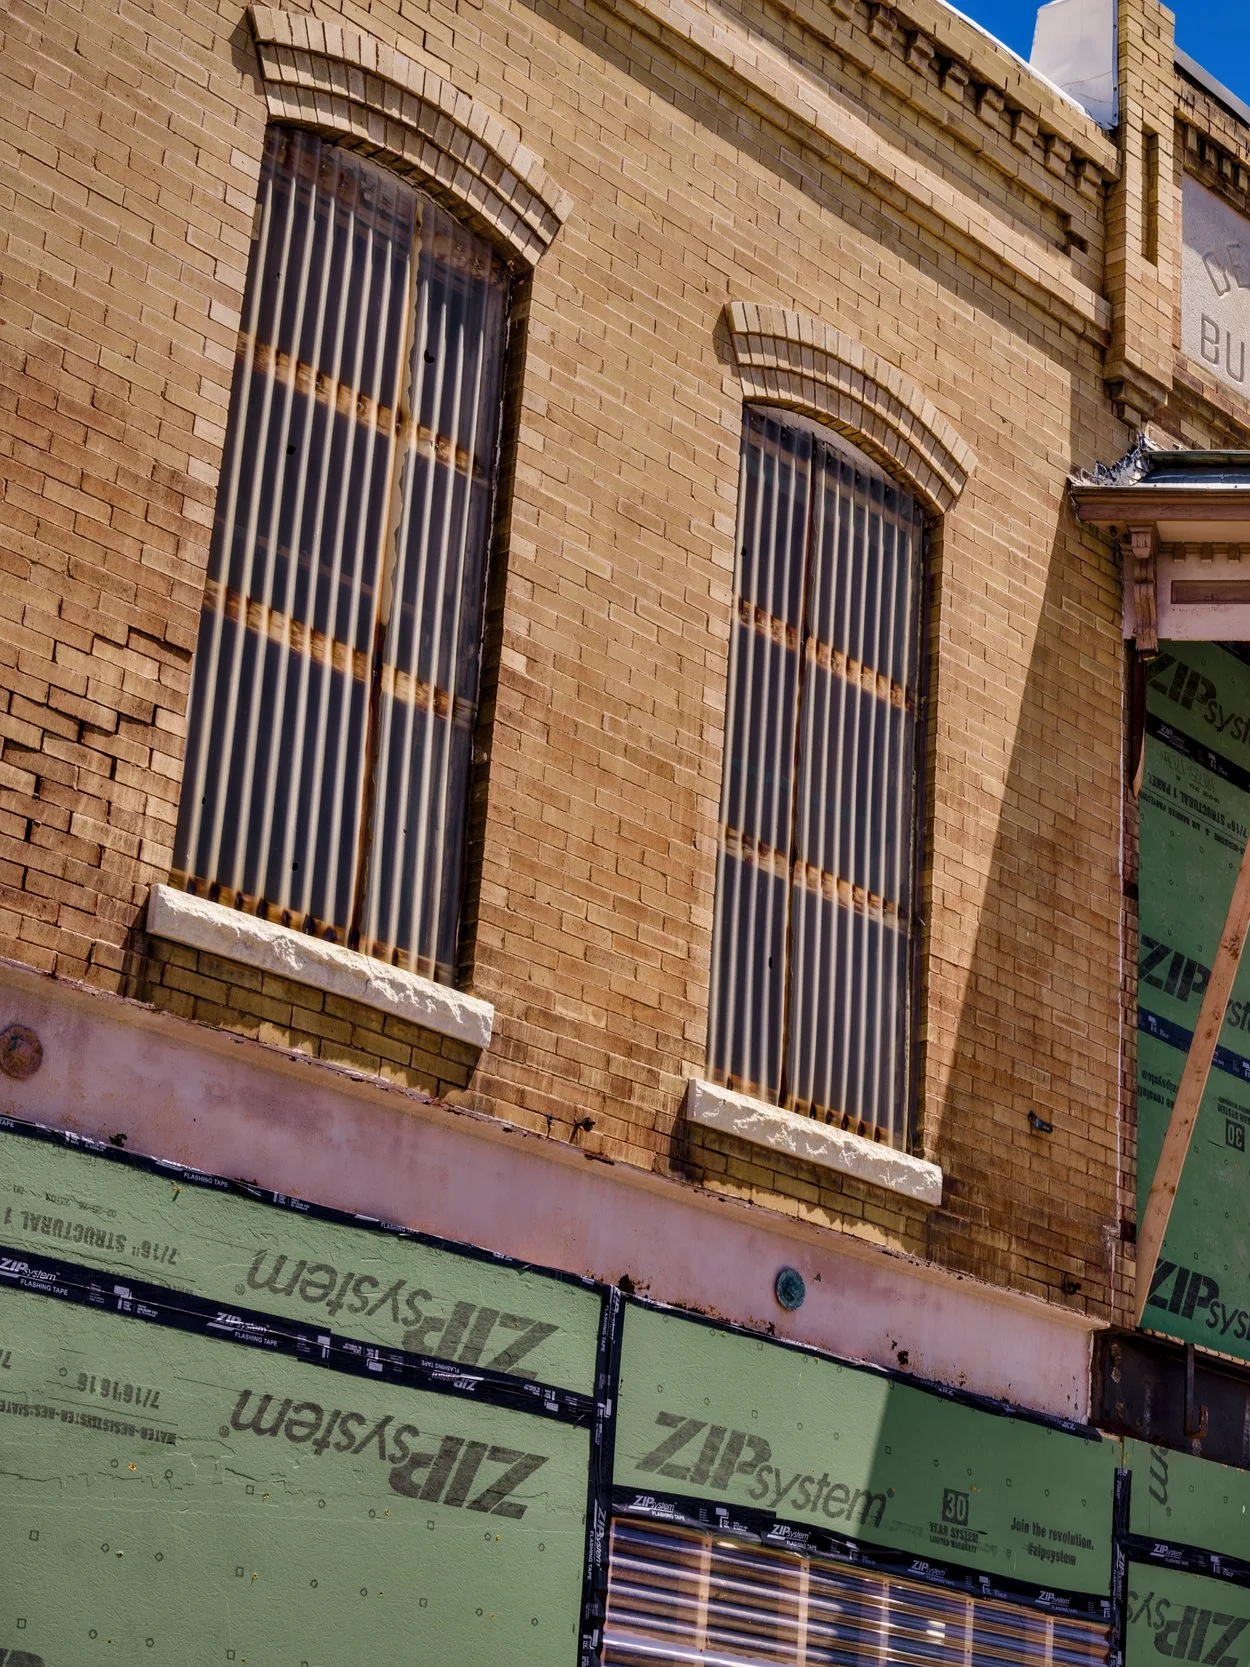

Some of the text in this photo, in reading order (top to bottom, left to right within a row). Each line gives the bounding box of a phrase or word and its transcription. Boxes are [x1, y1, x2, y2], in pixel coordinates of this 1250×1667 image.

[1227, 1122, 1243, 1149] 30
[183, 1171, 229, 1188] FLASHING TAPE
[20, 1210, 127, 1253] STRUCTURAL
[131, 1240, 180, 1265] 7/16"
[0, 1257, 57, 1283] ZIPsystem
[20, 1279, 69, 1296] FLASHING TAPE
[247, 1249, 560, 1380] ZIPsystem
[234, 1331, 278, 1347] FLASHING TAPE
[421, 1359, 460, 1374] FLASHING TAPE
[230, 1389, 549, 1520] ZIPsystem
[635, 1411, 888, 1528] ZIPsystem
[632, 1494, 676, 1513] ZIPsystem
[651, 1510, 686, 1522] FLASHING TAPE
[944, 1490, 969, 1523] 30
[596, 1507, 607, 1568] ZIPsystem
[771, 1523, 809, 1542] ZIPsystem
[929, 1521, 949, 1537] YEAR
[950, 1526, 979, 1544] SYSTEM
[1010, 1516, 1095, 1551] Join the revolution.
[1027, 1542, 1077, 1567] #zipsystem
[910, 1559, 947, 1577] ZIPsystem
